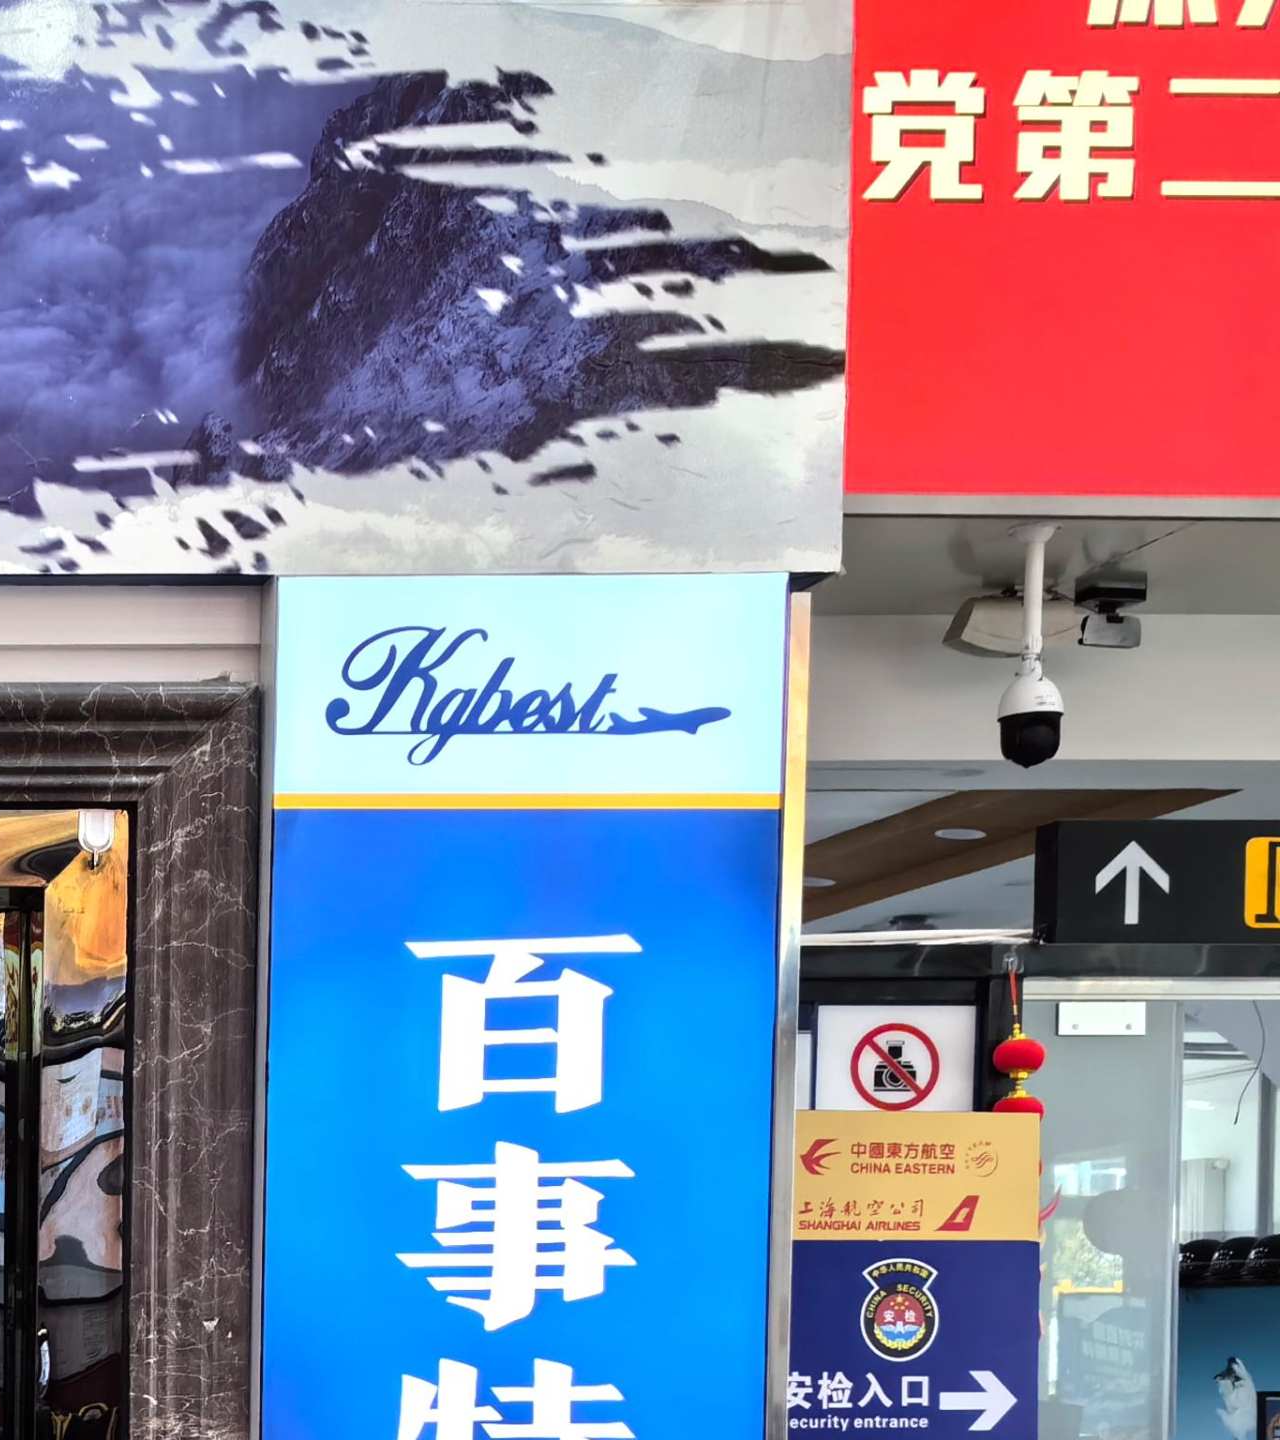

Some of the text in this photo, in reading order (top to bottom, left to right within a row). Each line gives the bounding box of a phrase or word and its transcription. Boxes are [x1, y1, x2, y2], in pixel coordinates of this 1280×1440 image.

[850, 1142, 955, 1160] 中國東方航空
[850, 1162, 956, 1175] CHINA EASTERN
[798, 1198, 925, 1218] 上海航空公司
[798, 1220, 921, 1232] SHANGHAI AIRLINES
[866, 1283, 933, 1318] CHINA SECURITY
[787, 1371, 930, 1409] 安检入口
[789, 1415, 929, 1431] ecurity entrance
